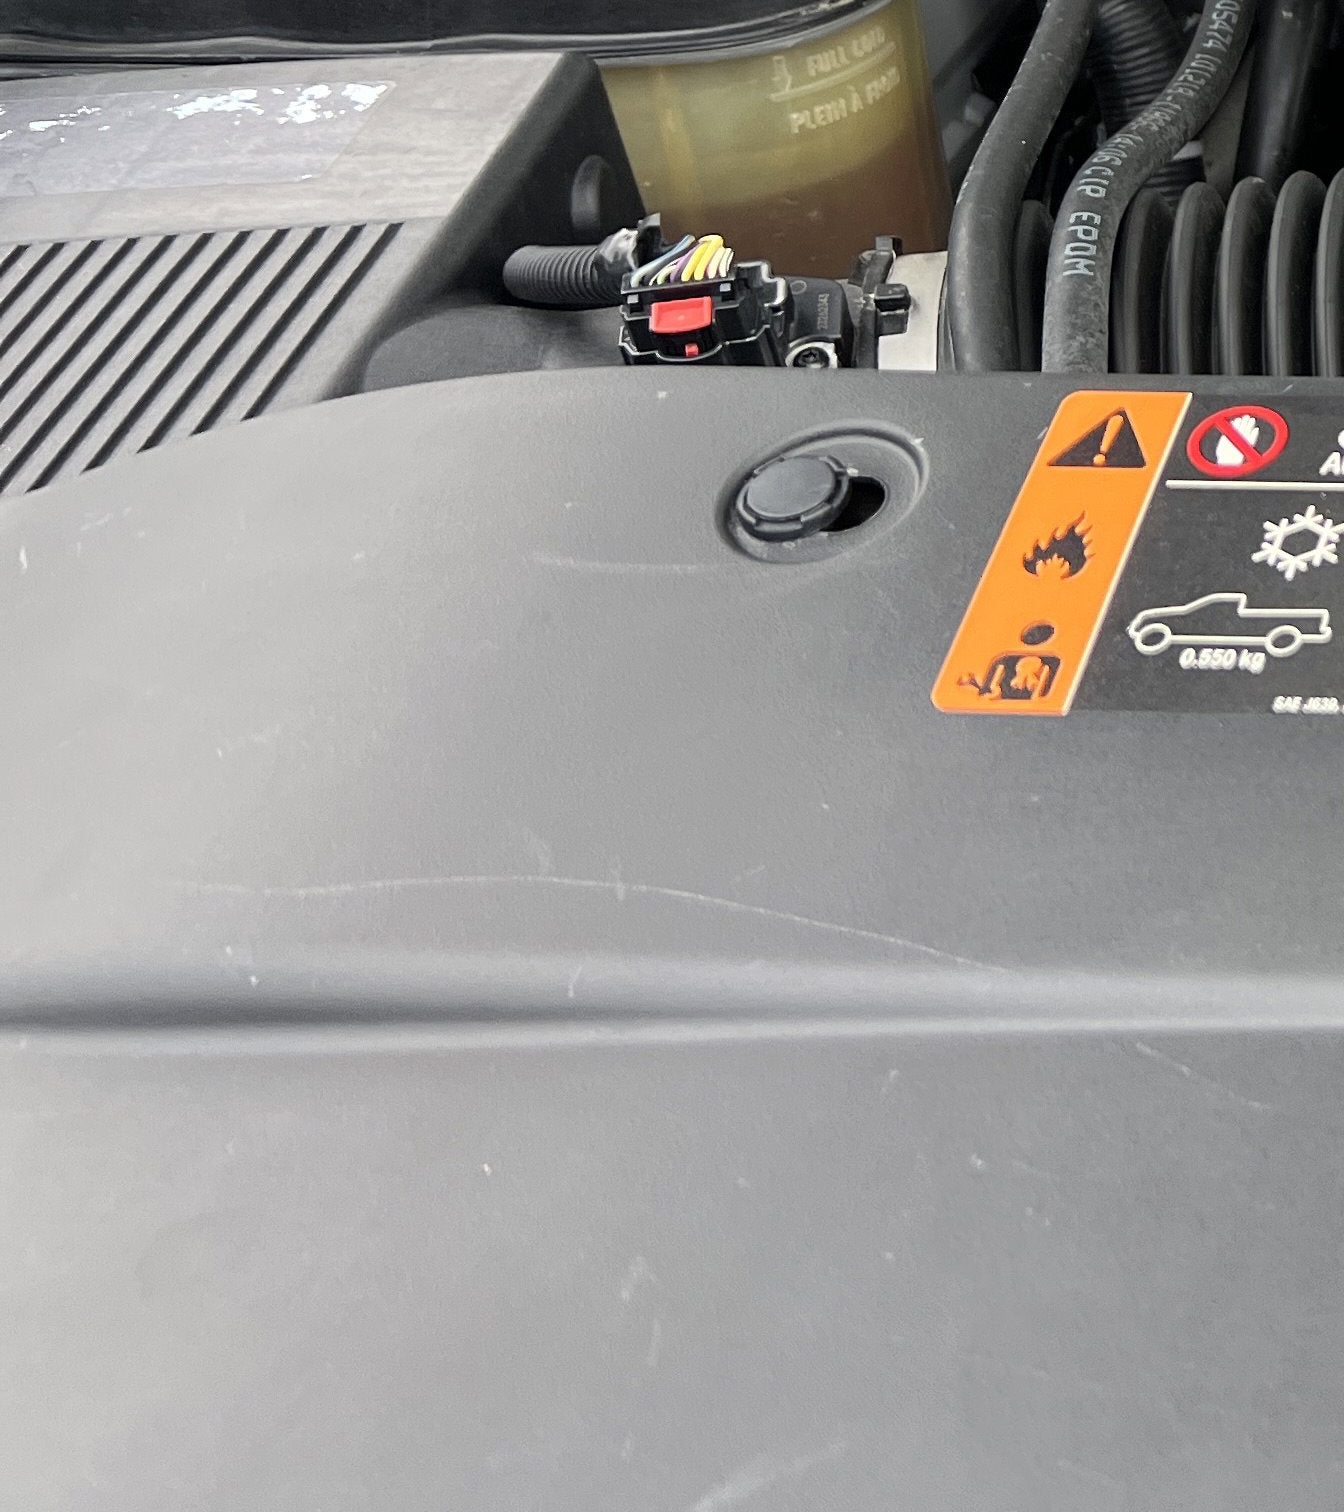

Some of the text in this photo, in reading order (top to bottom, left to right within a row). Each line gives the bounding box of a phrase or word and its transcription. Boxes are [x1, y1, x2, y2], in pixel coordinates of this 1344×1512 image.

[1178, 647, 1266, 674] 0.550 kg
[1272, 695, 1302, 714] SAE
